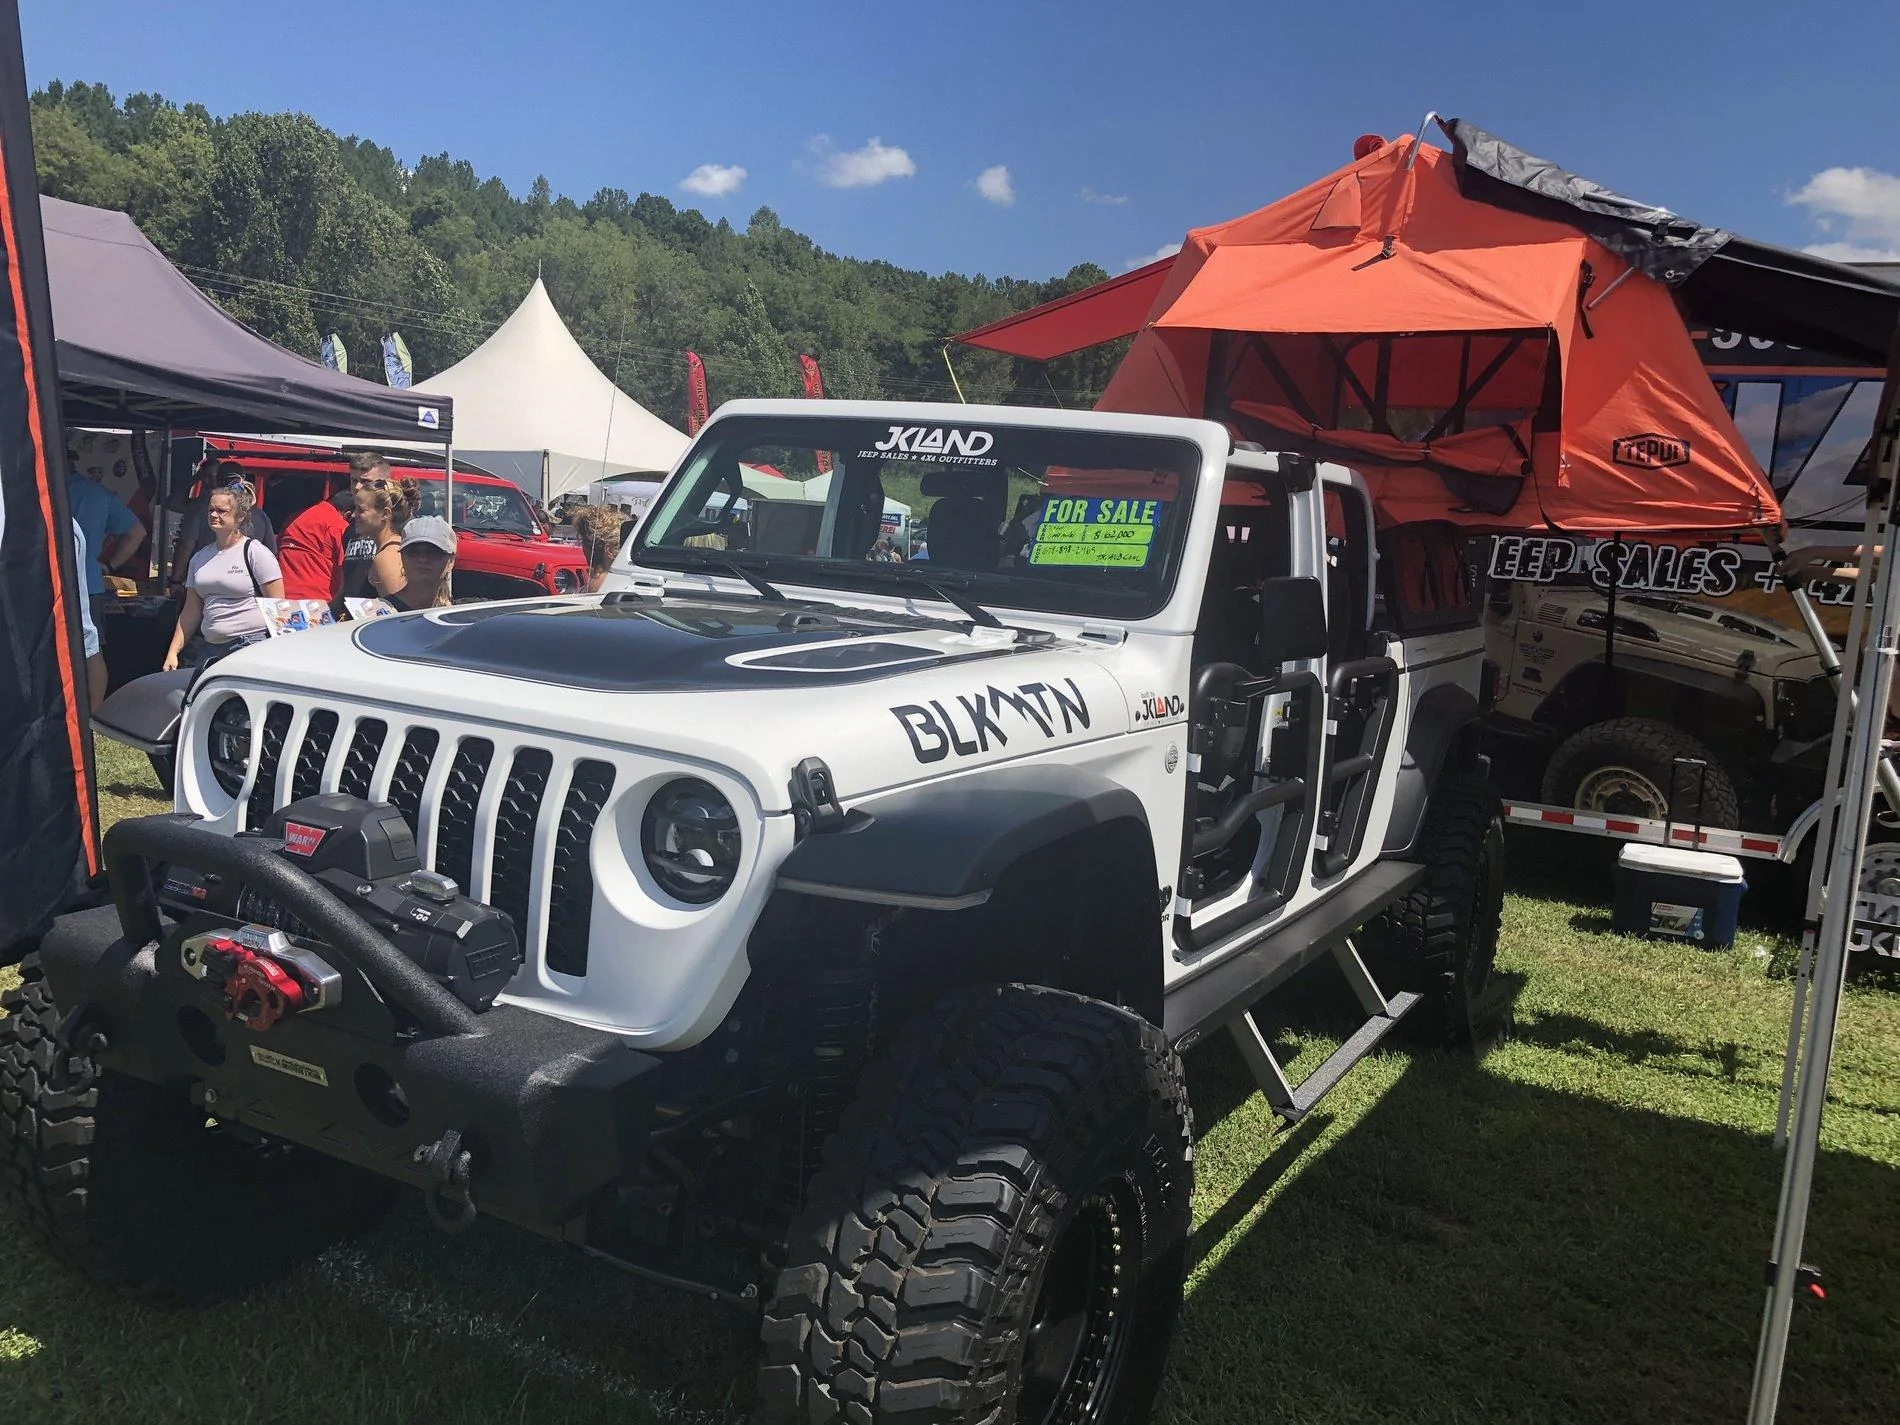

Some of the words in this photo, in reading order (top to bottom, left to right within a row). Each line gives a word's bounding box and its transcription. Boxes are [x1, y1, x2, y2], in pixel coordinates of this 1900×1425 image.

[874, 426, 994, 457] JKLAND
[1625, 440, 1679, 464] TEPUI
[857, 450, 879, 459] JEEP
[880, 451, 910, 461] SALES
[938, 456, 998, 467] OUTFITTERS
[1043, 499, 1089, 523] FOR
[1096, 499, 1158, 524] SALE
[1591, 541, 1741, 597] SALES
[1142, 694, 1181, 721] JKLAND
